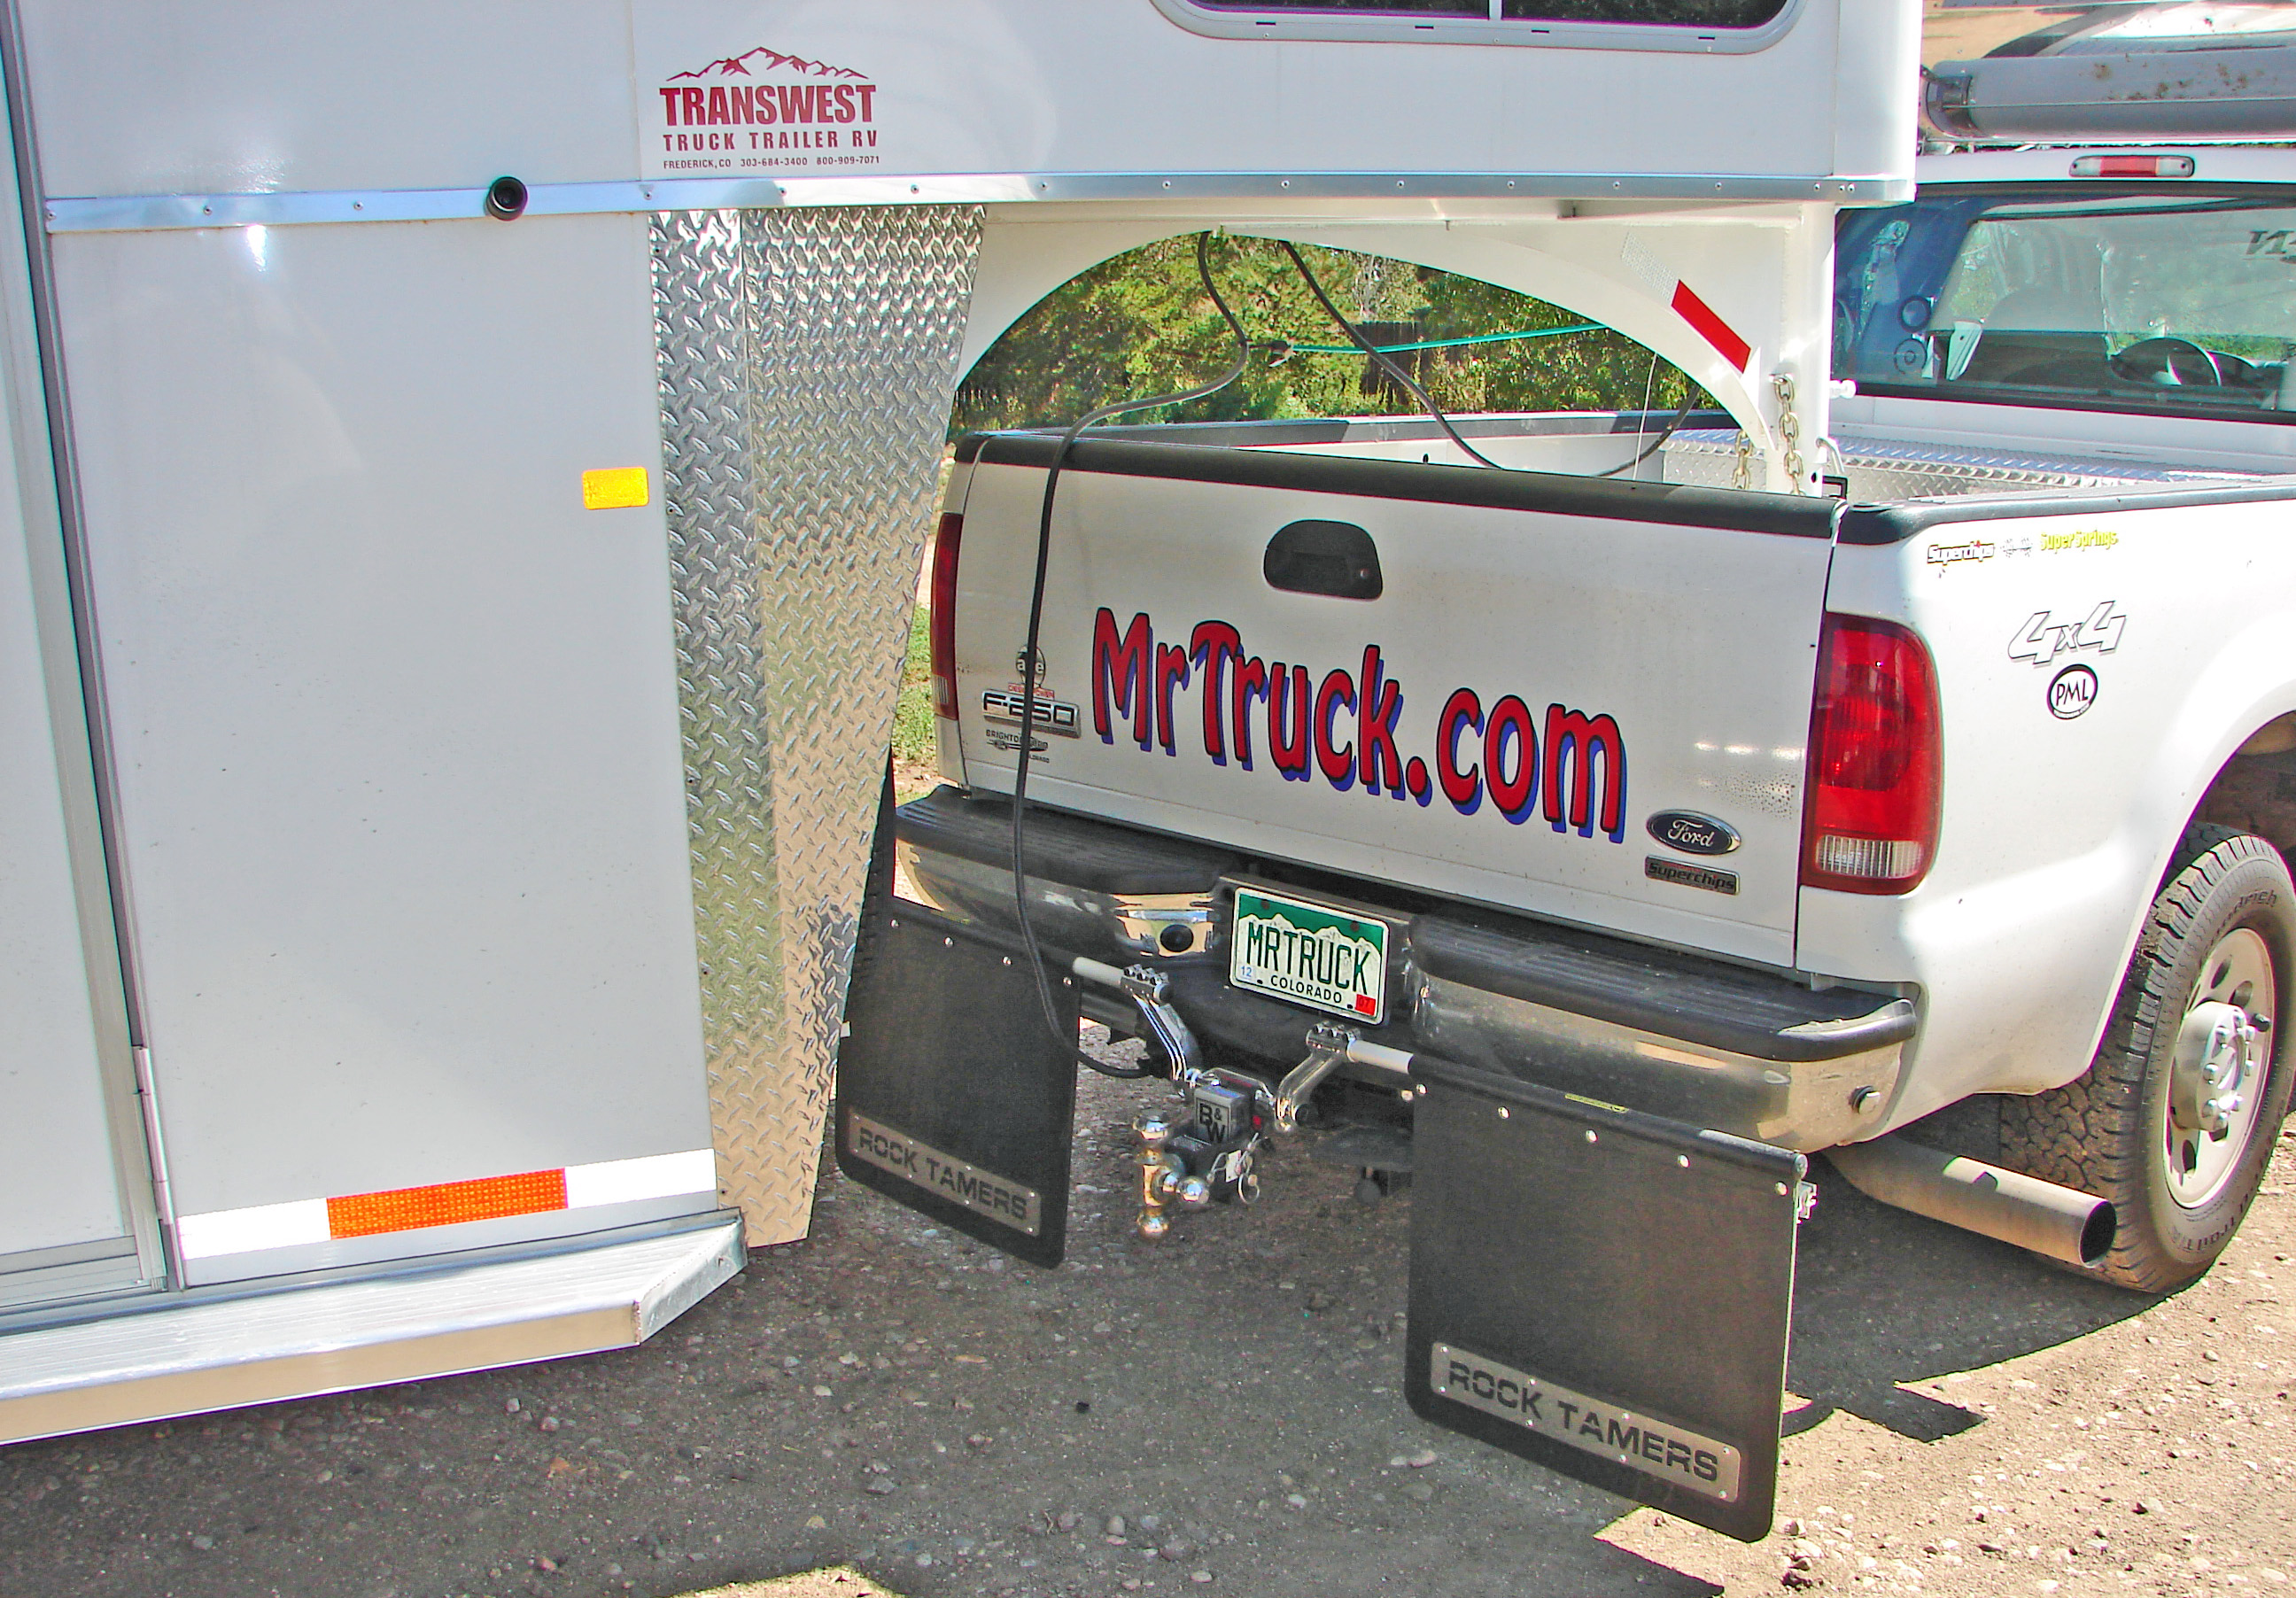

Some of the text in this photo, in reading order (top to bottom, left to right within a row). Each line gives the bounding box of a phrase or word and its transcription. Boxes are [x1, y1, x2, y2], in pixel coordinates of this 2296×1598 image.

[659, 84, 876, 126] TRANSWEST
[663, 129, 878, 151] TRUCK TRAILER RV
[741, 157, 808, 167] 303-684-3400
[816, 155, 880, 166] 800-909-7071
[2007, 600, 2127, 666] 4x4
[2056, 678, 2089, 706] PML
[1092, 607, 1627, 843] MrTruck.com
[1667, 818, 1715, 847] Ford
[1648, 862, 1735, 889] Superchips
[1246, 921, 1371, 995] MRTRUCK
[1240, 966, 1253, 978] 12
[1270, 974, 1342, 1004] COLORADO
[859, 1126, 1028, 1221] ROCK TAMERS
[1448, 1360, 1718, 1482] ROCK TAMERS
